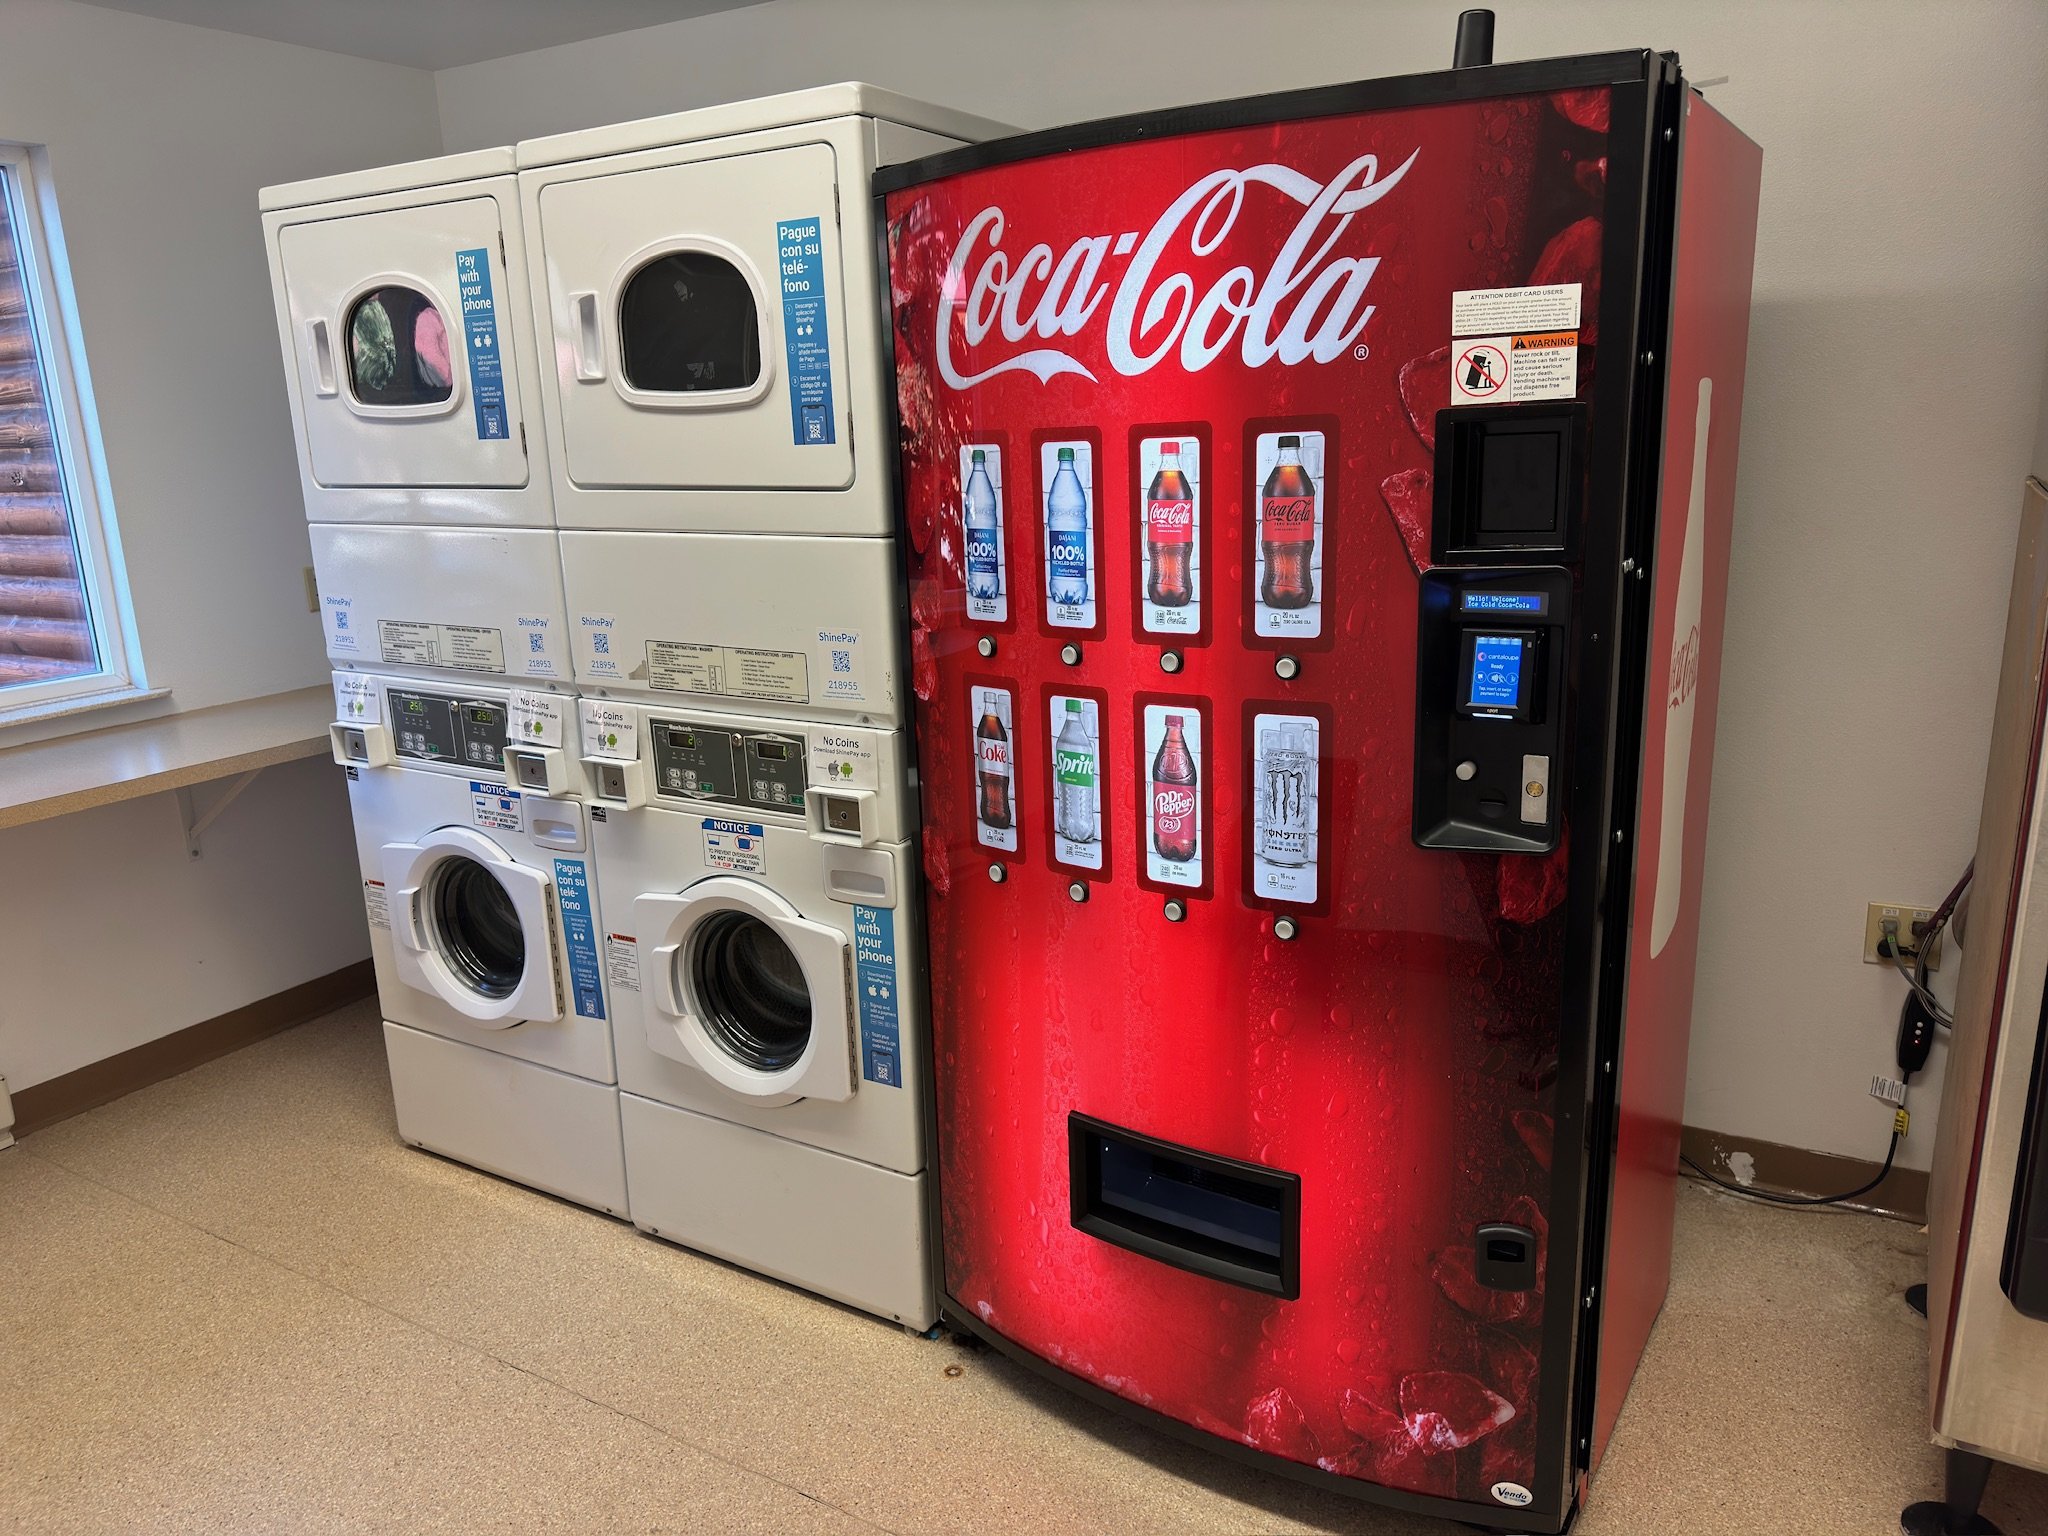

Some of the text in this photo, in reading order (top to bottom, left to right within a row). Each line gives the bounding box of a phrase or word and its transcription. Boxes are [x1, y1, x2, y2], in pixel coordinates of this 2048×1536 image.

[780, 226, 816, 242] Pague
[782, 243, 819, 258] con su
[458, 254, 475, 269] Pay
[782, 259, 808, 276] telé-
[936, 146, 1421, 390] Coca-Cola
[460, 268, 480, 283] with
[784, 278, 810, 292] fono
[462, 285, 482, 300] your
[464, 298, 492, 314] phone
[1528, 337, 1574, 348] WARNING
[1150, 503, 1190, 524] Coca-Cola
[1265, 500, 1311, 522] Coca-Cola
[969, 542, 996, 557] 100%
[1052, 545, 1084, 560] 100%
[327, 597, 350, 607] ShinePay
[518, 618, 548, 628] ShinePay
[582, 617, 613, 628] ShinePay
[336, 635, 354, 643] 218952
[819, 632, 856, 644] ShinePay
[529, 660, 551, 668] 218953
[592, 660, 615, 669] 218954
[829, 680, 857, 690] 218955
[521, 697, 549, 710] No Coins
[477, 711, 491, 720] 250
[592, 710, 623, 721] No Coins
[603, 721, 622, 729] ShinePay
[823, 736, 859, 748] No Coins
[814, 746, 835, 754] Download
[980, 741, 1006, 764] Coke
[1057, 752, 1093, 775] Sprite
[480, 784, 510, 796] NOTICE
[1169, 790, 1183, 802] Dr
[1159, 792, 1192, 815] Pepper
[714, 821, 749, 833] NOTICE
[1164, 820, 1174, 829] 23
[1263, 828, 1307, 840] MONSTER
[732, 851, 760, 860] OVERSUDSING,
[556, 862, 582, 876] Pague
[733, 864, 756, 872] DETERGENT
[558, 876, 585, 886] con su
[560, 887, 578, 897] telé-
[562, 898, 580, 910] fono
[856, 906, 876, 922] Pay
[857, 922, 880, 936] with
[858, 936, 882, 948] your
[859, 948, 892, 964] phone
[1497, 1487, 1526, 1500] Vendo
